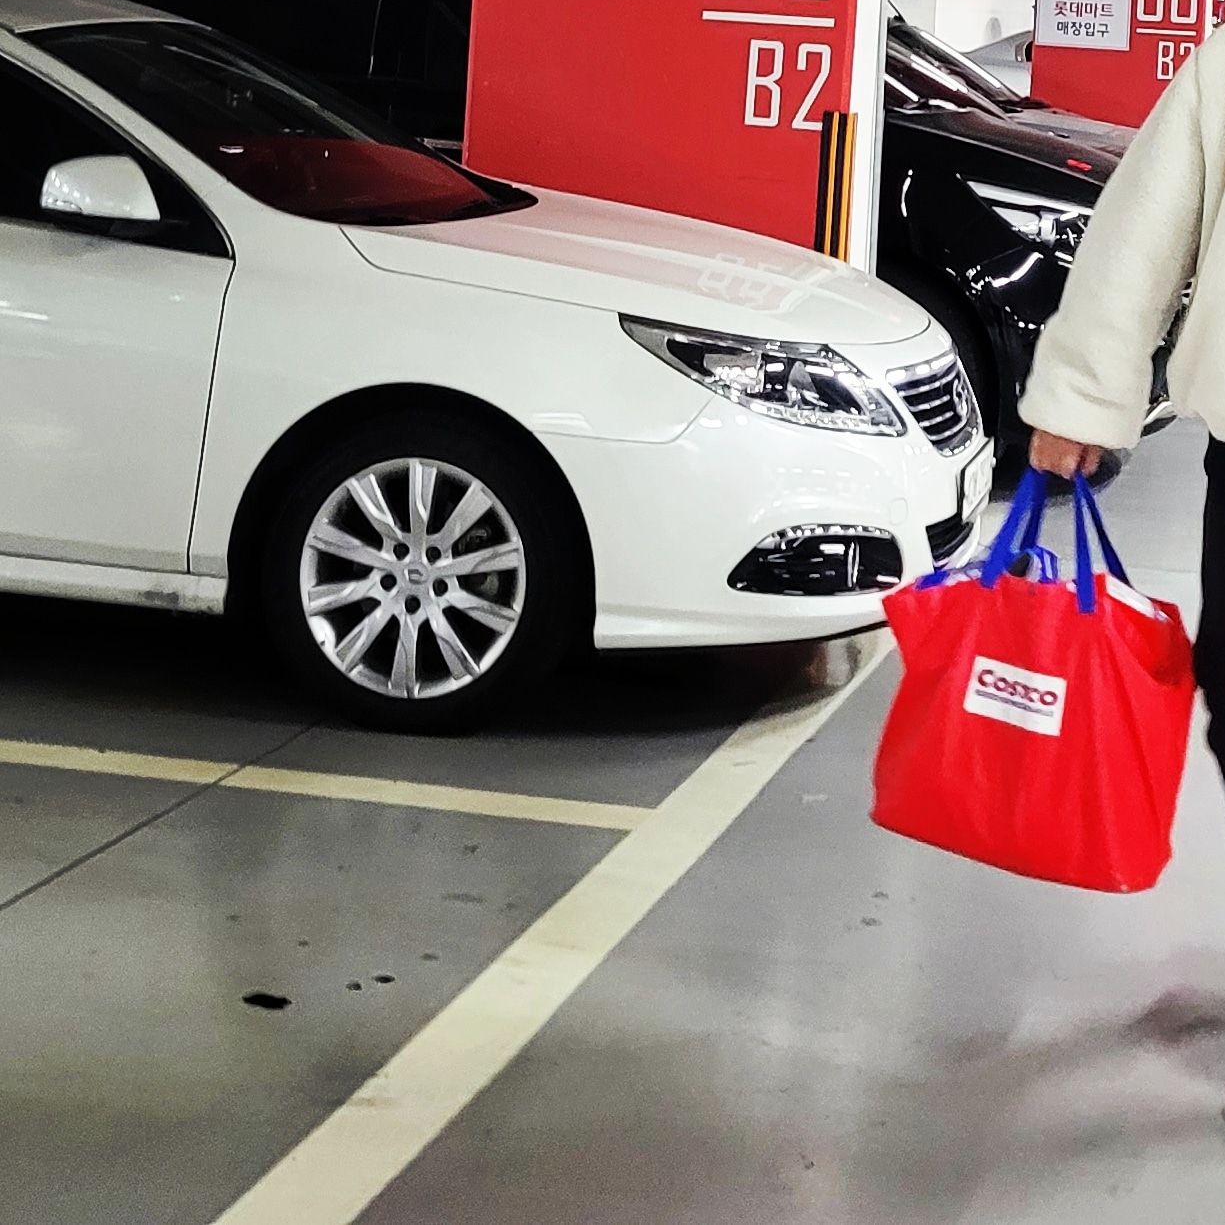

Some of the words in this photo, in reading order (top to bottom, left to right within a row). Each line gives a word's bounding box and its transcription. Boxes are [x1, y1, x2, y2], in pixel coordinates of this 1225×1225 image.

[1053, 1, 1115, 19] 롯데마트
[1056, 21, 1110, 38] 매장입구
[744, 38, 831, 131] B2
